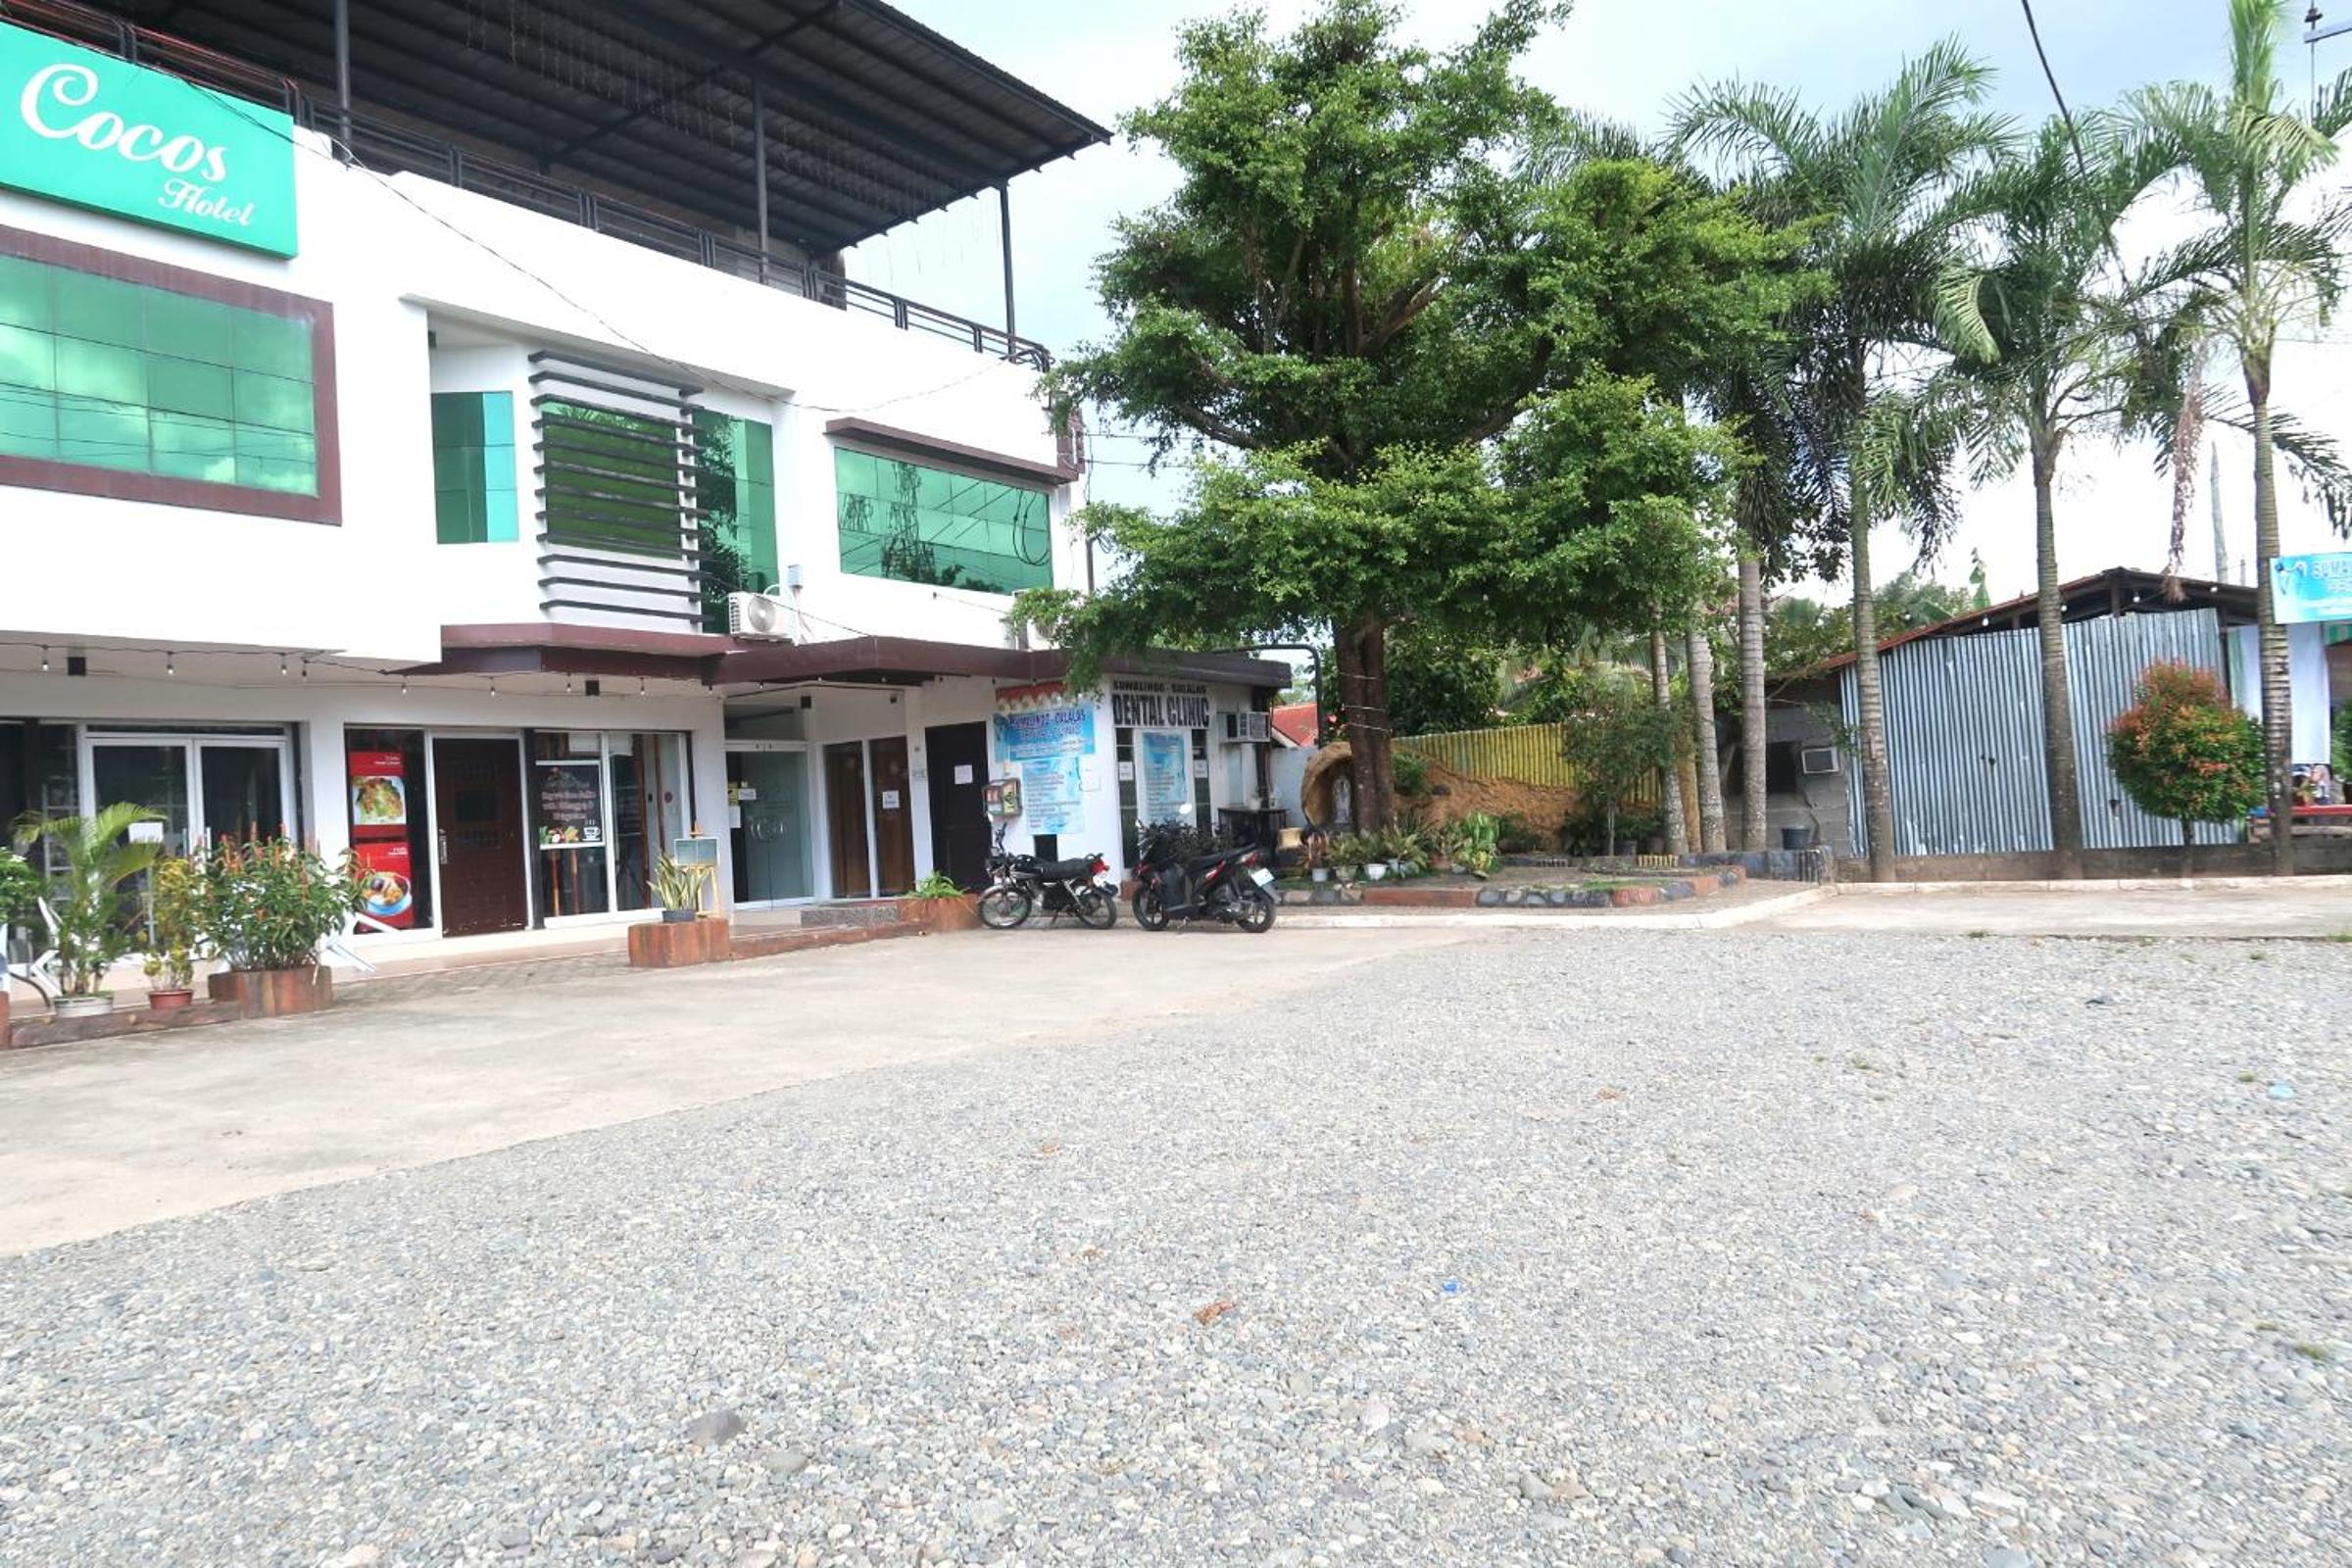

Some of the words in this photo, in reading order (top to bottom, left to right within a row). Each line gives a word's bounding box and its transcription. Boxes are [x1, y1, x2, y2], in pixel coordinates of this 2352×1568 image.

[21, 63, 228, 182] Cocos
[158, 177, 255, 226] Hotel
[1111, 694, 1165, 726] DENTAL
[1166, 696, 1210, 728] CLINIC
